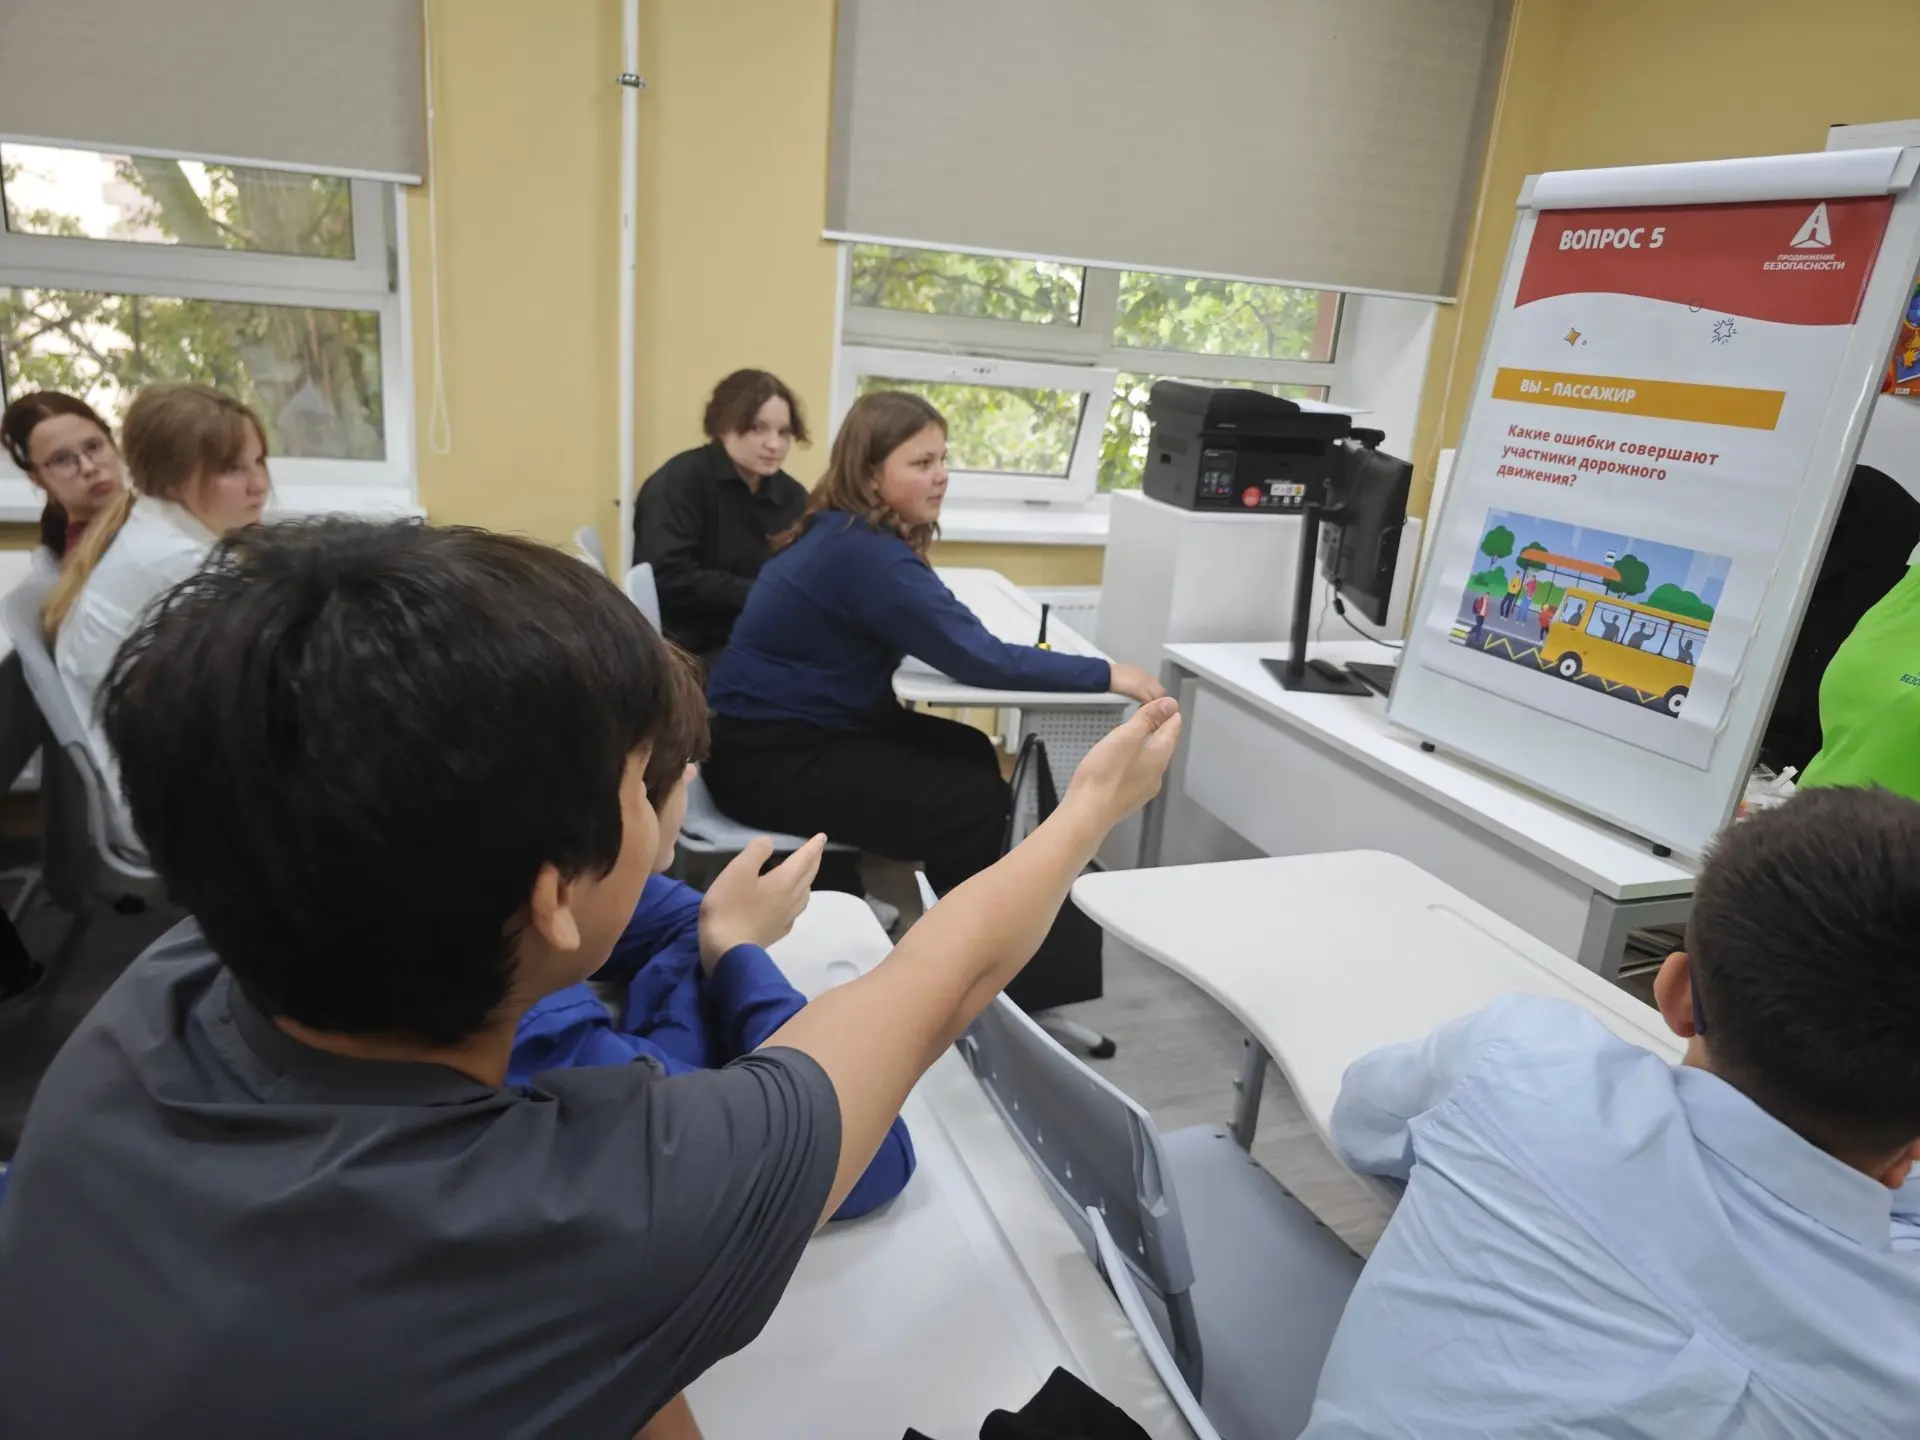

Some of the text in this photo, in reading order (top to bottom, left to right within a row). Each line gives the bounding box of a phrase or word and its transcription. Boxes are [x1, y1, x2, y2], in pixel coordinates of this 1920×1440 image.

[1559, 227, 1666, 250] ВОПРОС 5
[1763, 261, 1846, 271] БЕЗОПАСНОСТИ
[1520, 379, 1542, 394] ВЫ
[1552, 382, 1636, 402] ПАССАЖИР
[1508, 424, 1719, 466] Какие ошибки совершают
[1502, 445, 1667, 481] участники дорожного
[1497, 464, 1577, 487] движения?
